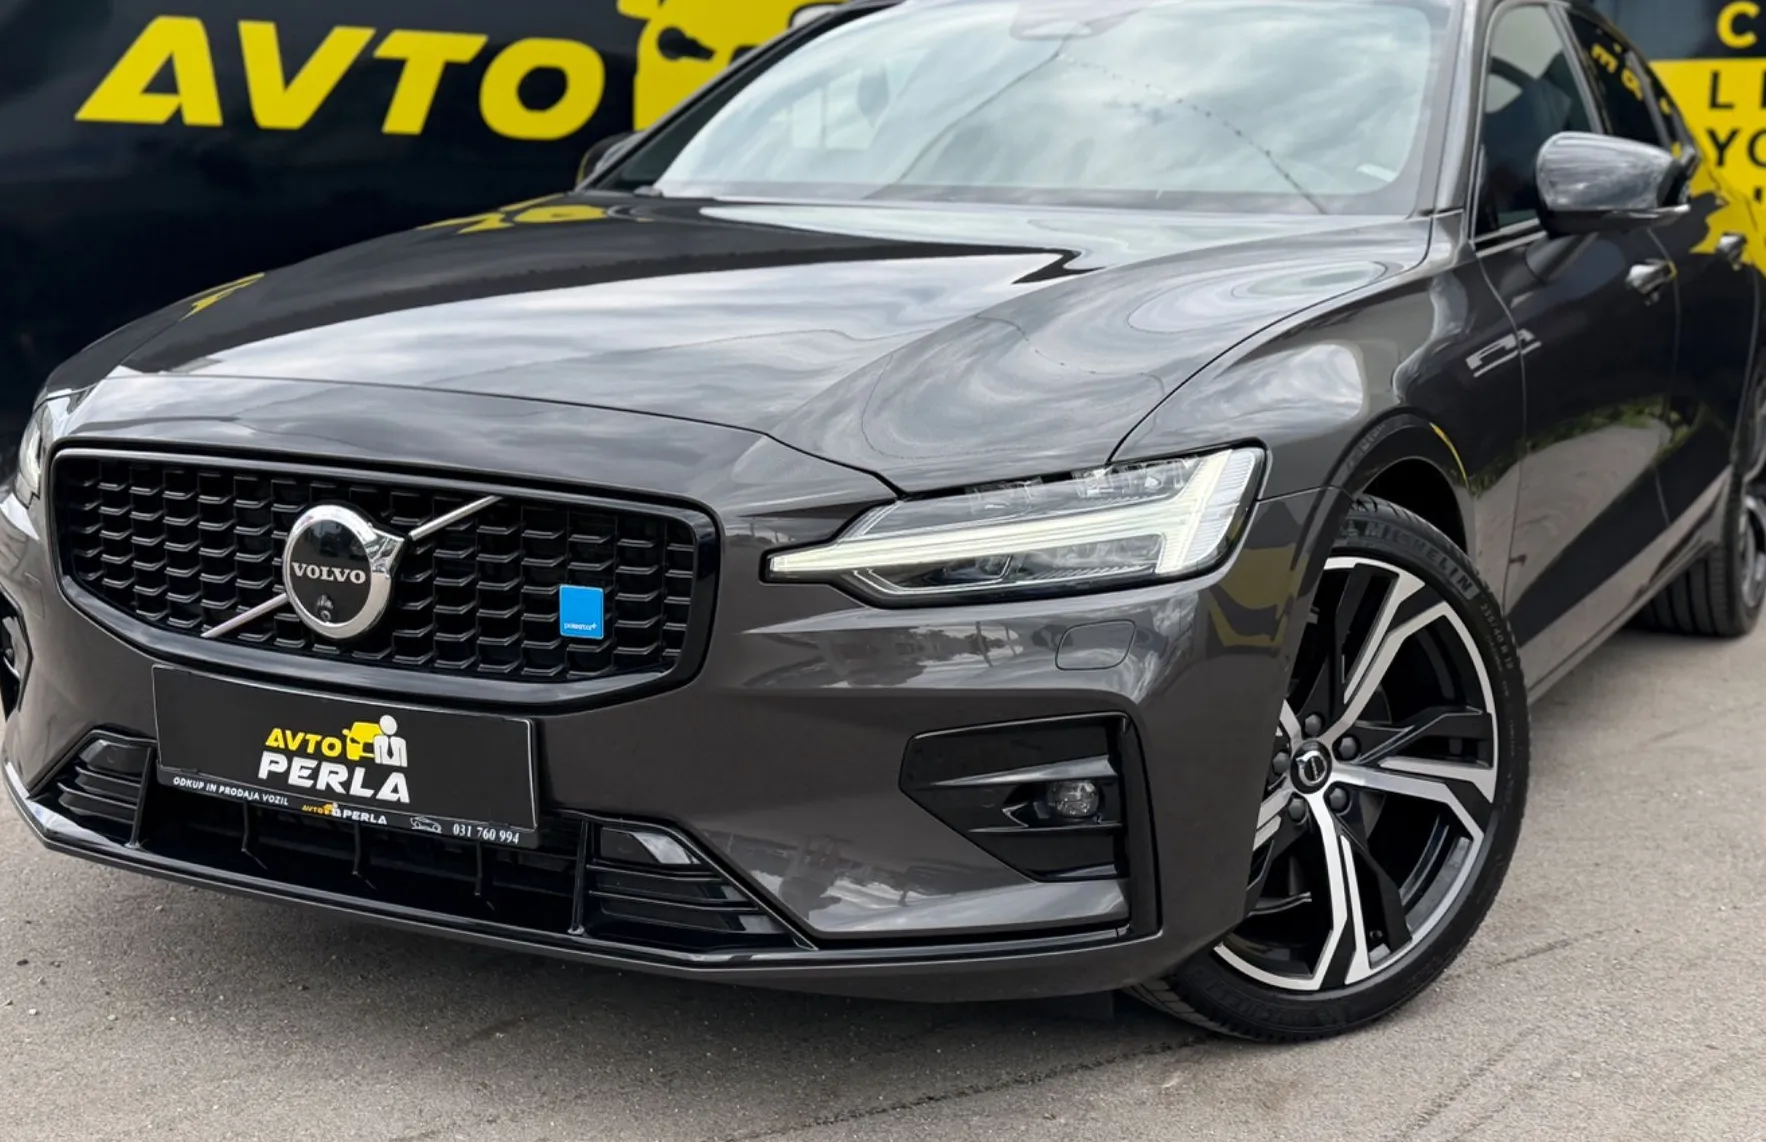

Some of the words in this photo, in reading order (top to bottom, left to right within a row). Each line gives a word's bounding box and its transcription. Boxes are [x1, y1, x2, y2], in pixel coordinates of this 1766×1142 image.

[74, 15, 605, 140] AVTO
[291, 562, 366, 584] VOLVO
[265, 728, 342, 757] AVTO
[173, 776, 204, 790] ODKUP
[206, 783, 217, 793] IN
[219, 785, 260, 801] PRODAJA
[262, 793, 289, 806] VOZIL
[257, 750, 410, 804] PERLA
[343, 809, 387, 825] PERLA
[453, 823, 472, 838] 031
[476, 827, 496, 841] 760
[500, 830, 520, 844] 994
